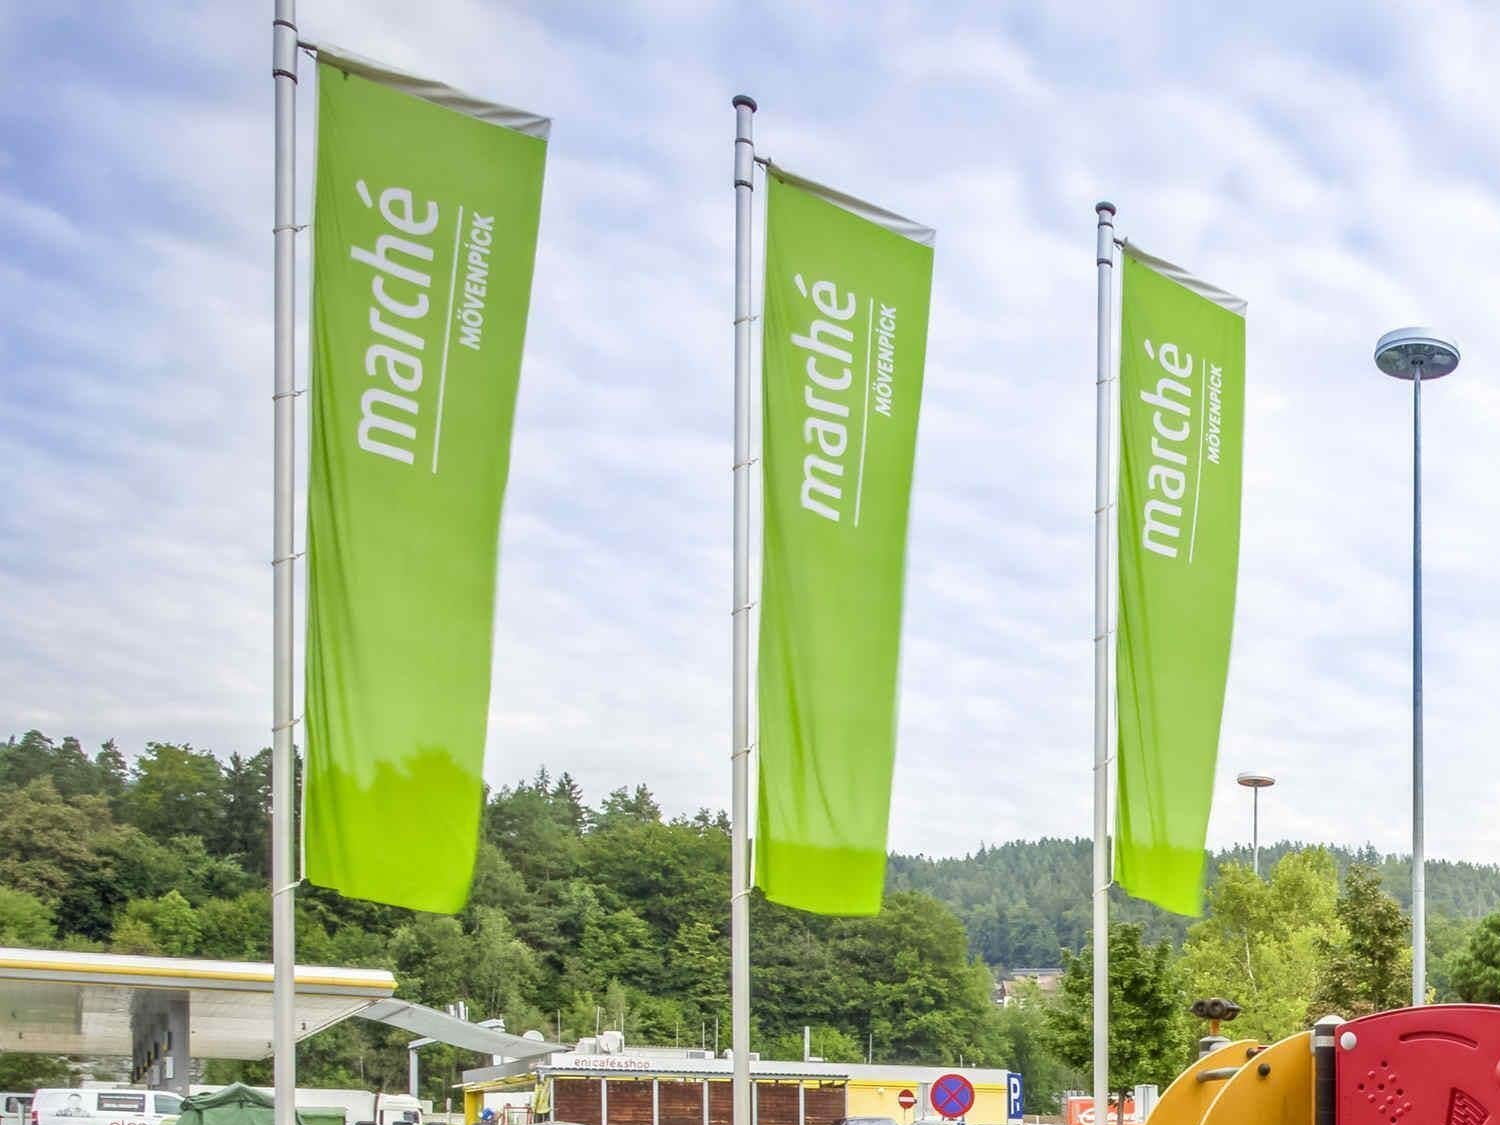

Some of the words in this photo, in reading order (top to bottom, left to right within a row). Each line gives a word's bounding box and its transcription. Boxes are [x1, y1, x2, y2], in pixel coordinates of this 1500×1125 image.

[350, 178, 440, 465] marché
[790, 273, 857, 522] marché
[1140, 338, 1193, 558] marché
[1010, 1077, 1021, 1115] P
